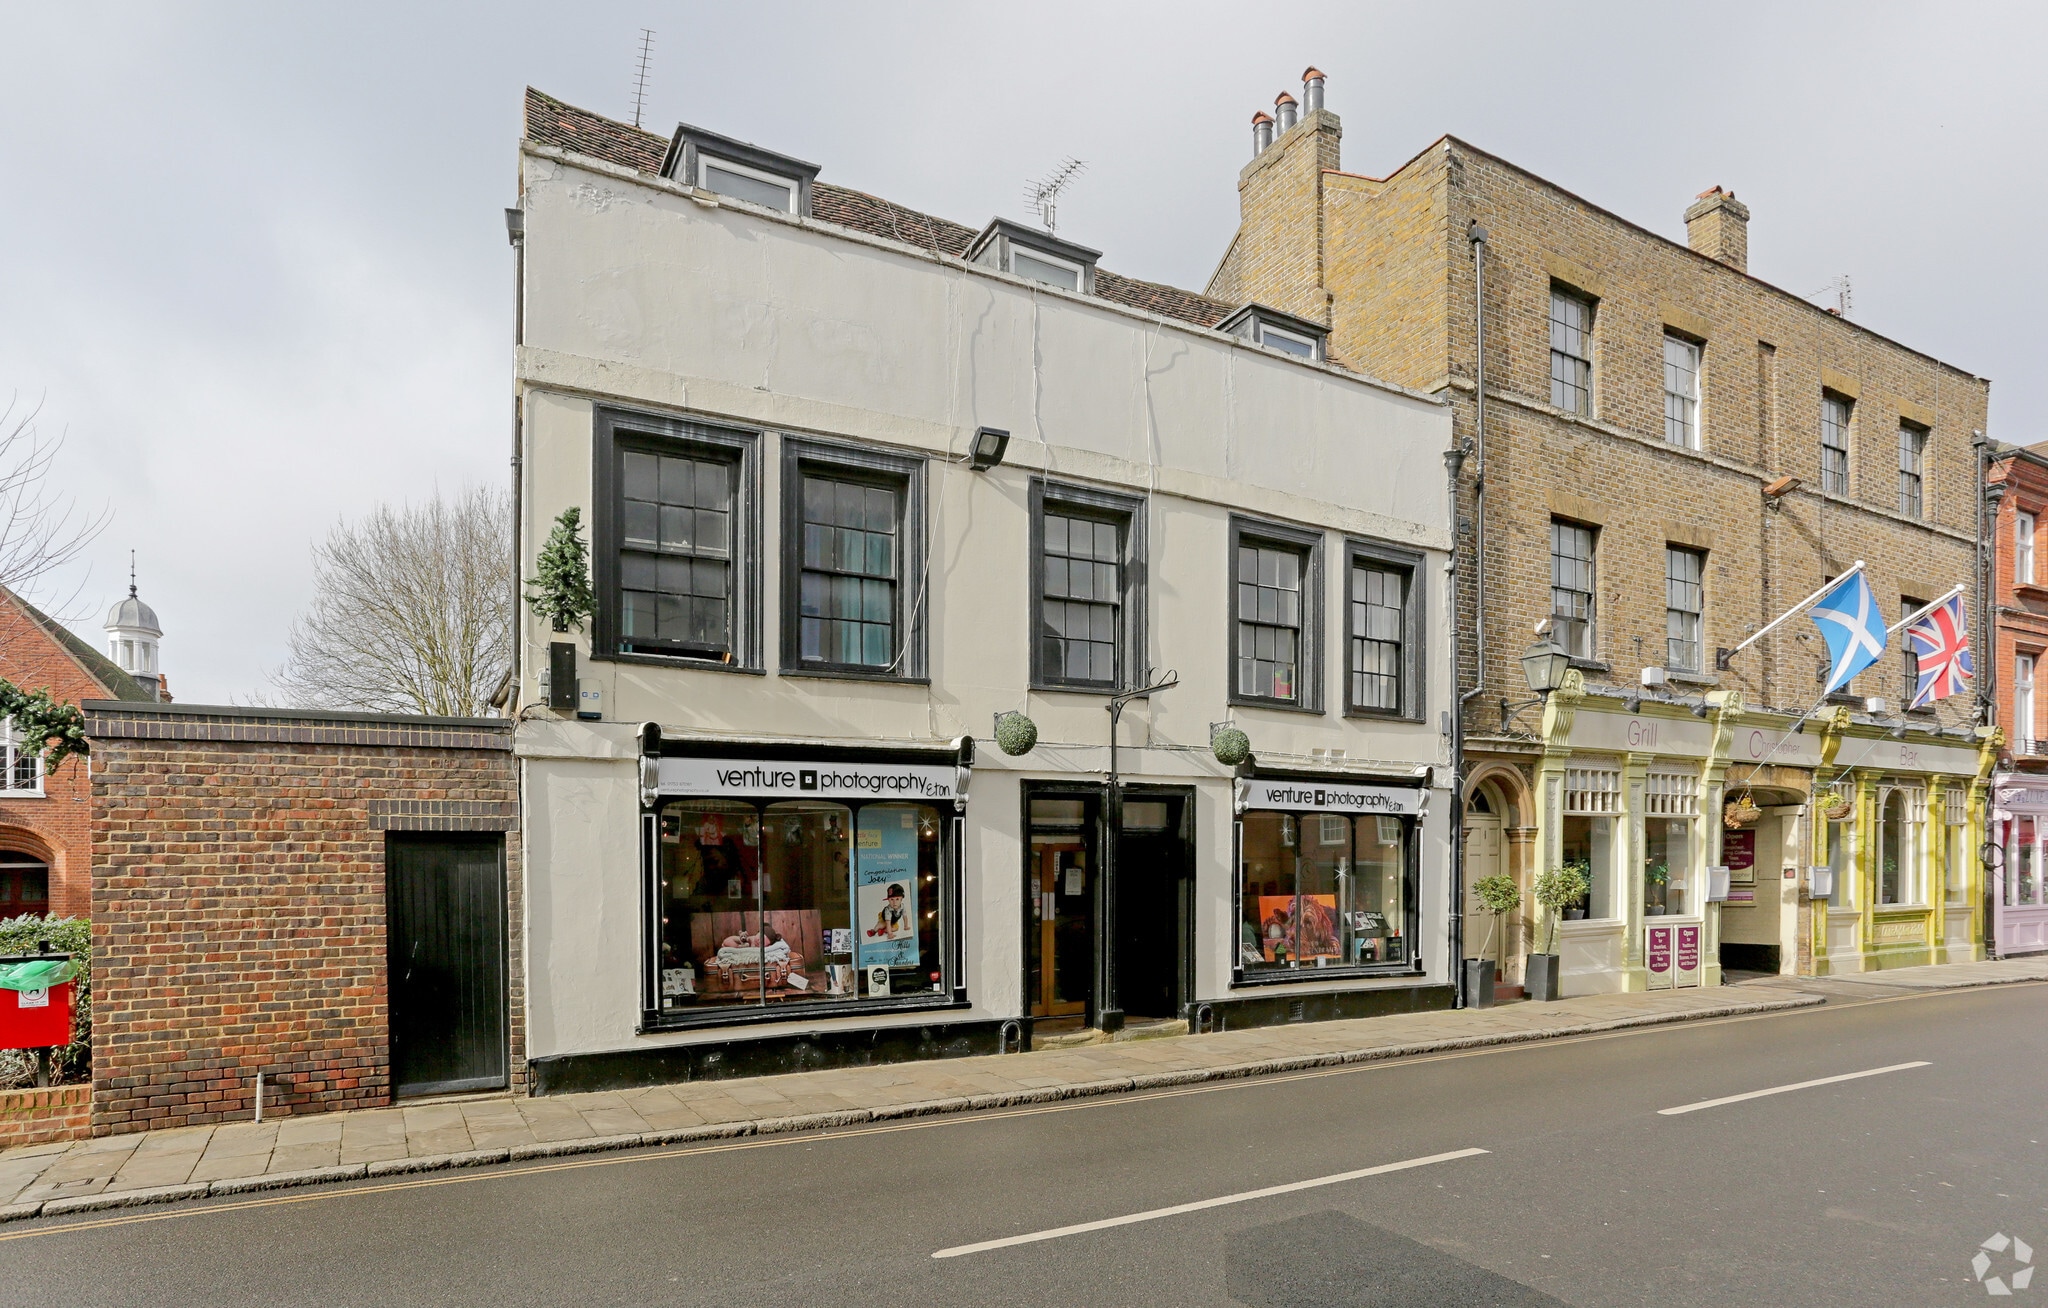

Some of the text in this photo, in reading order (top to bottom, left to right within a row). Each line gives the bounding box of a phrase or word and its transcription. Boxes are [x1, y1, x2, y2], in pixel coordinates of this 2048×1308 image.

[1628, 720, 1658, 747] Grill
[1749, 730, 1800, 758] Christopher
[1900, 746, 1918, 767] Bar
[716, 766, 796, 788] venture
[821, 770, 927, 794] photography
[926, 782, 950, 797] Eton
[1266, 787, 1312, 804] venture
[1326, 791, 1390, 809] photography
[868, 876, 886, 884] Joey
